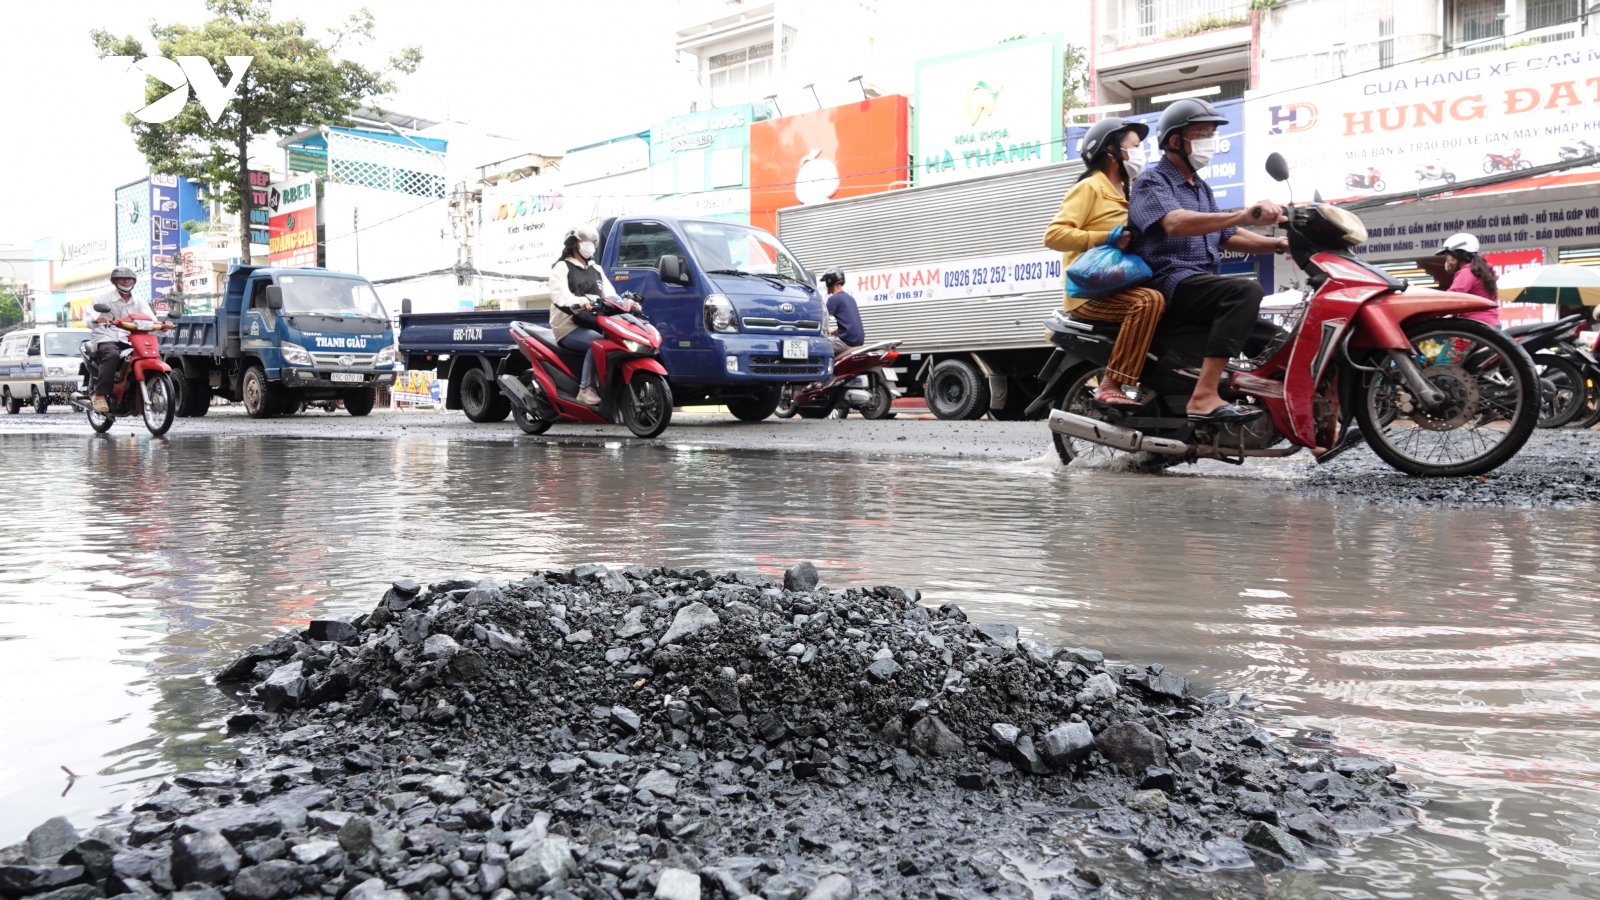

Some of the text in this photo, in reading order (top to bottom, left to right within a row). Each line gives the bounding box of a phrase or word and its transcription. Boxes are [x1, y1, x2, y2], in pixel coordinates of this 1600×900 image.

[955, 128, 1009, 145] NHA KHOA
[926, 140, 1041, 174] HÀ THÀNH
[1397, 225, 1407, 236] XE
[1425, 220, 1442, 234] MÁY
[1443, 218, 1464, 232] NHẬP
[1488, 215, 1499, 228] CŨ
[1500, 214, 1511, 227] VÀ
[1512, 213, 1529, 226] MỚI
[1566, 208, 1583, 221] GÓP
[1585, 206, 1600, 220] VỚI
[507, 225, 520, 234] Kids
[1497, 231, 1512, 244] GIÁ
[1513, 229, 1529, 242] TỐT
[1368, 241, 1391, 254] CHÍNH
[1420, 239, 1440, 250] THAY
[858, 268, 941, 292] HUY NAM
[944, 269, 970, 288] 02926
[972, 267, 988, 285] 252
[990, 265, 1006, 284] 252
[1014, 262, 1042, 282] 02923
[1045, 260, 1061, 279] 740
[873, 293, 888, 302] 47H
[896, 290, 923, 300] 016.97
[453, 328, 482, 341] 65C-174.74
[315, 336, 367, 349] THANH GIÀU
[790, 341, 802, 349] 65C
